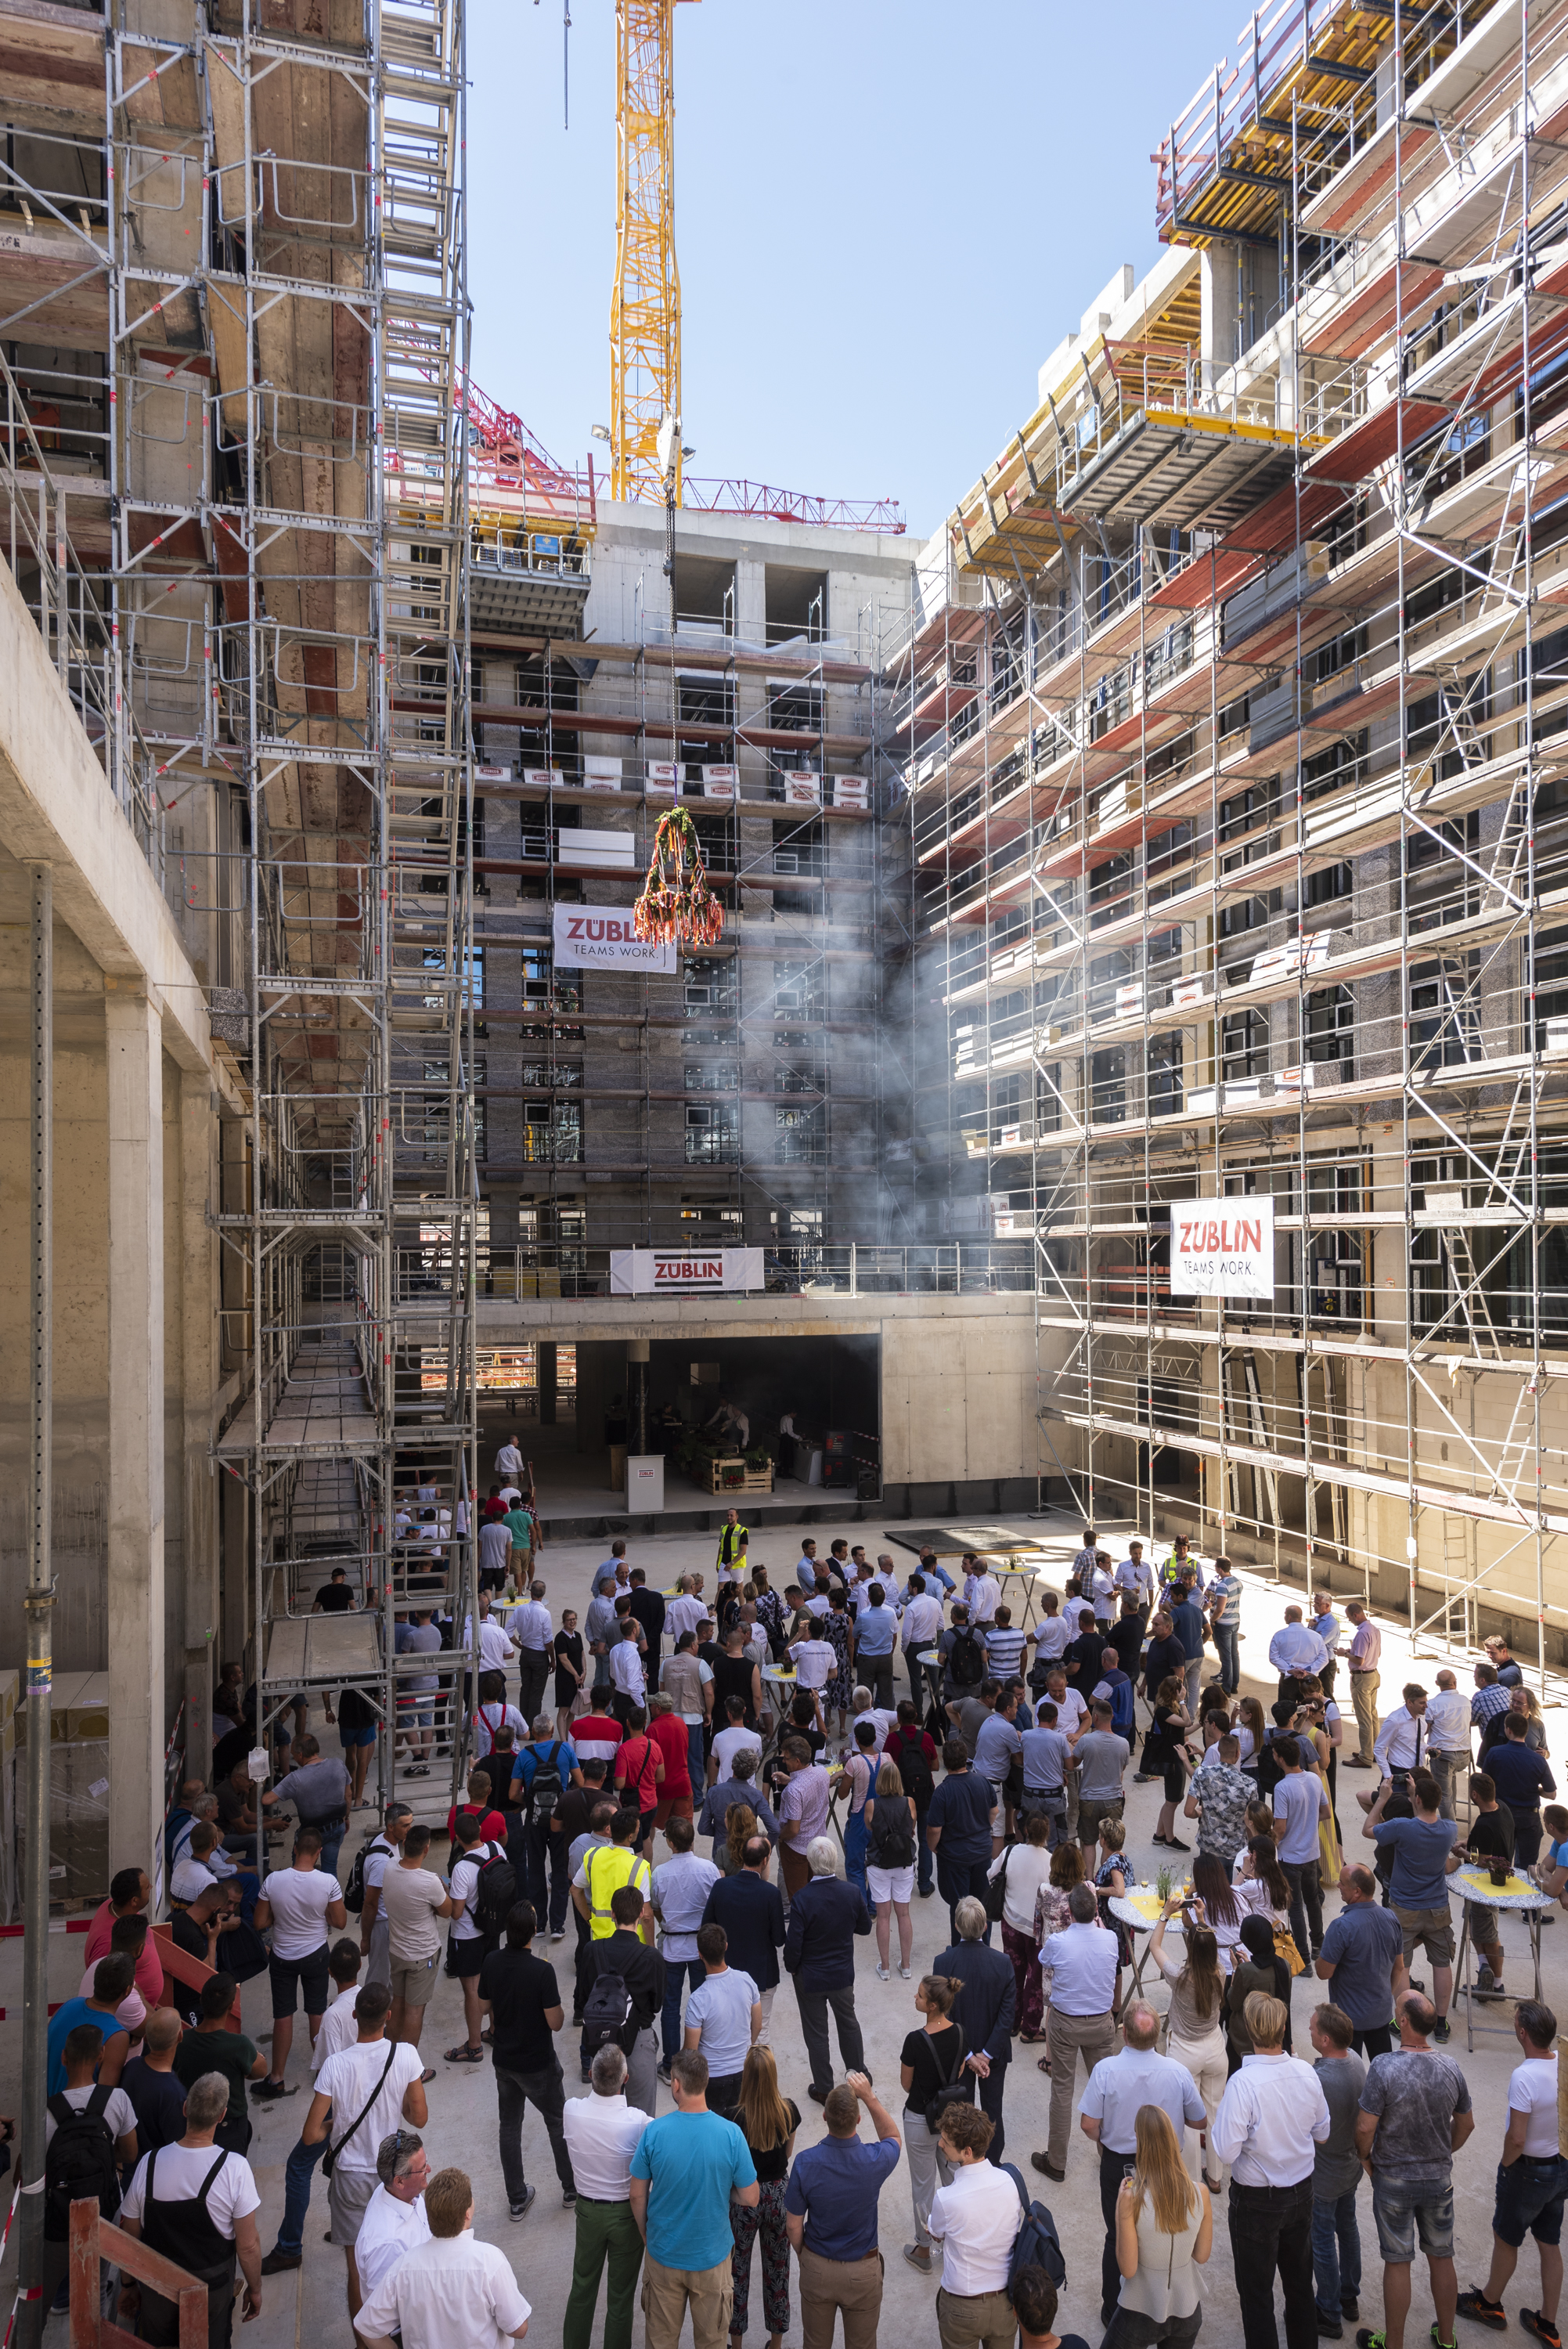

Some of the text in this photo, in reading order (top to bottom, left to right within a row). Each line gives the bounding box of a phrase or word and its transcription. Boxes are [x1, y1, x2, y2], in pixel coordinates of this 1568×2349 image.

[567, 918, 651, 944] ZÜBL
[574, 944, 658, 959] TEAMS WORK.
[1180, 1219, 1261, 1253] ZÜBLIN
[654, 1262, 723, 1279] ZÜBLIN
[1184, 1261, 1255, 1275] TEAMS WORK.
